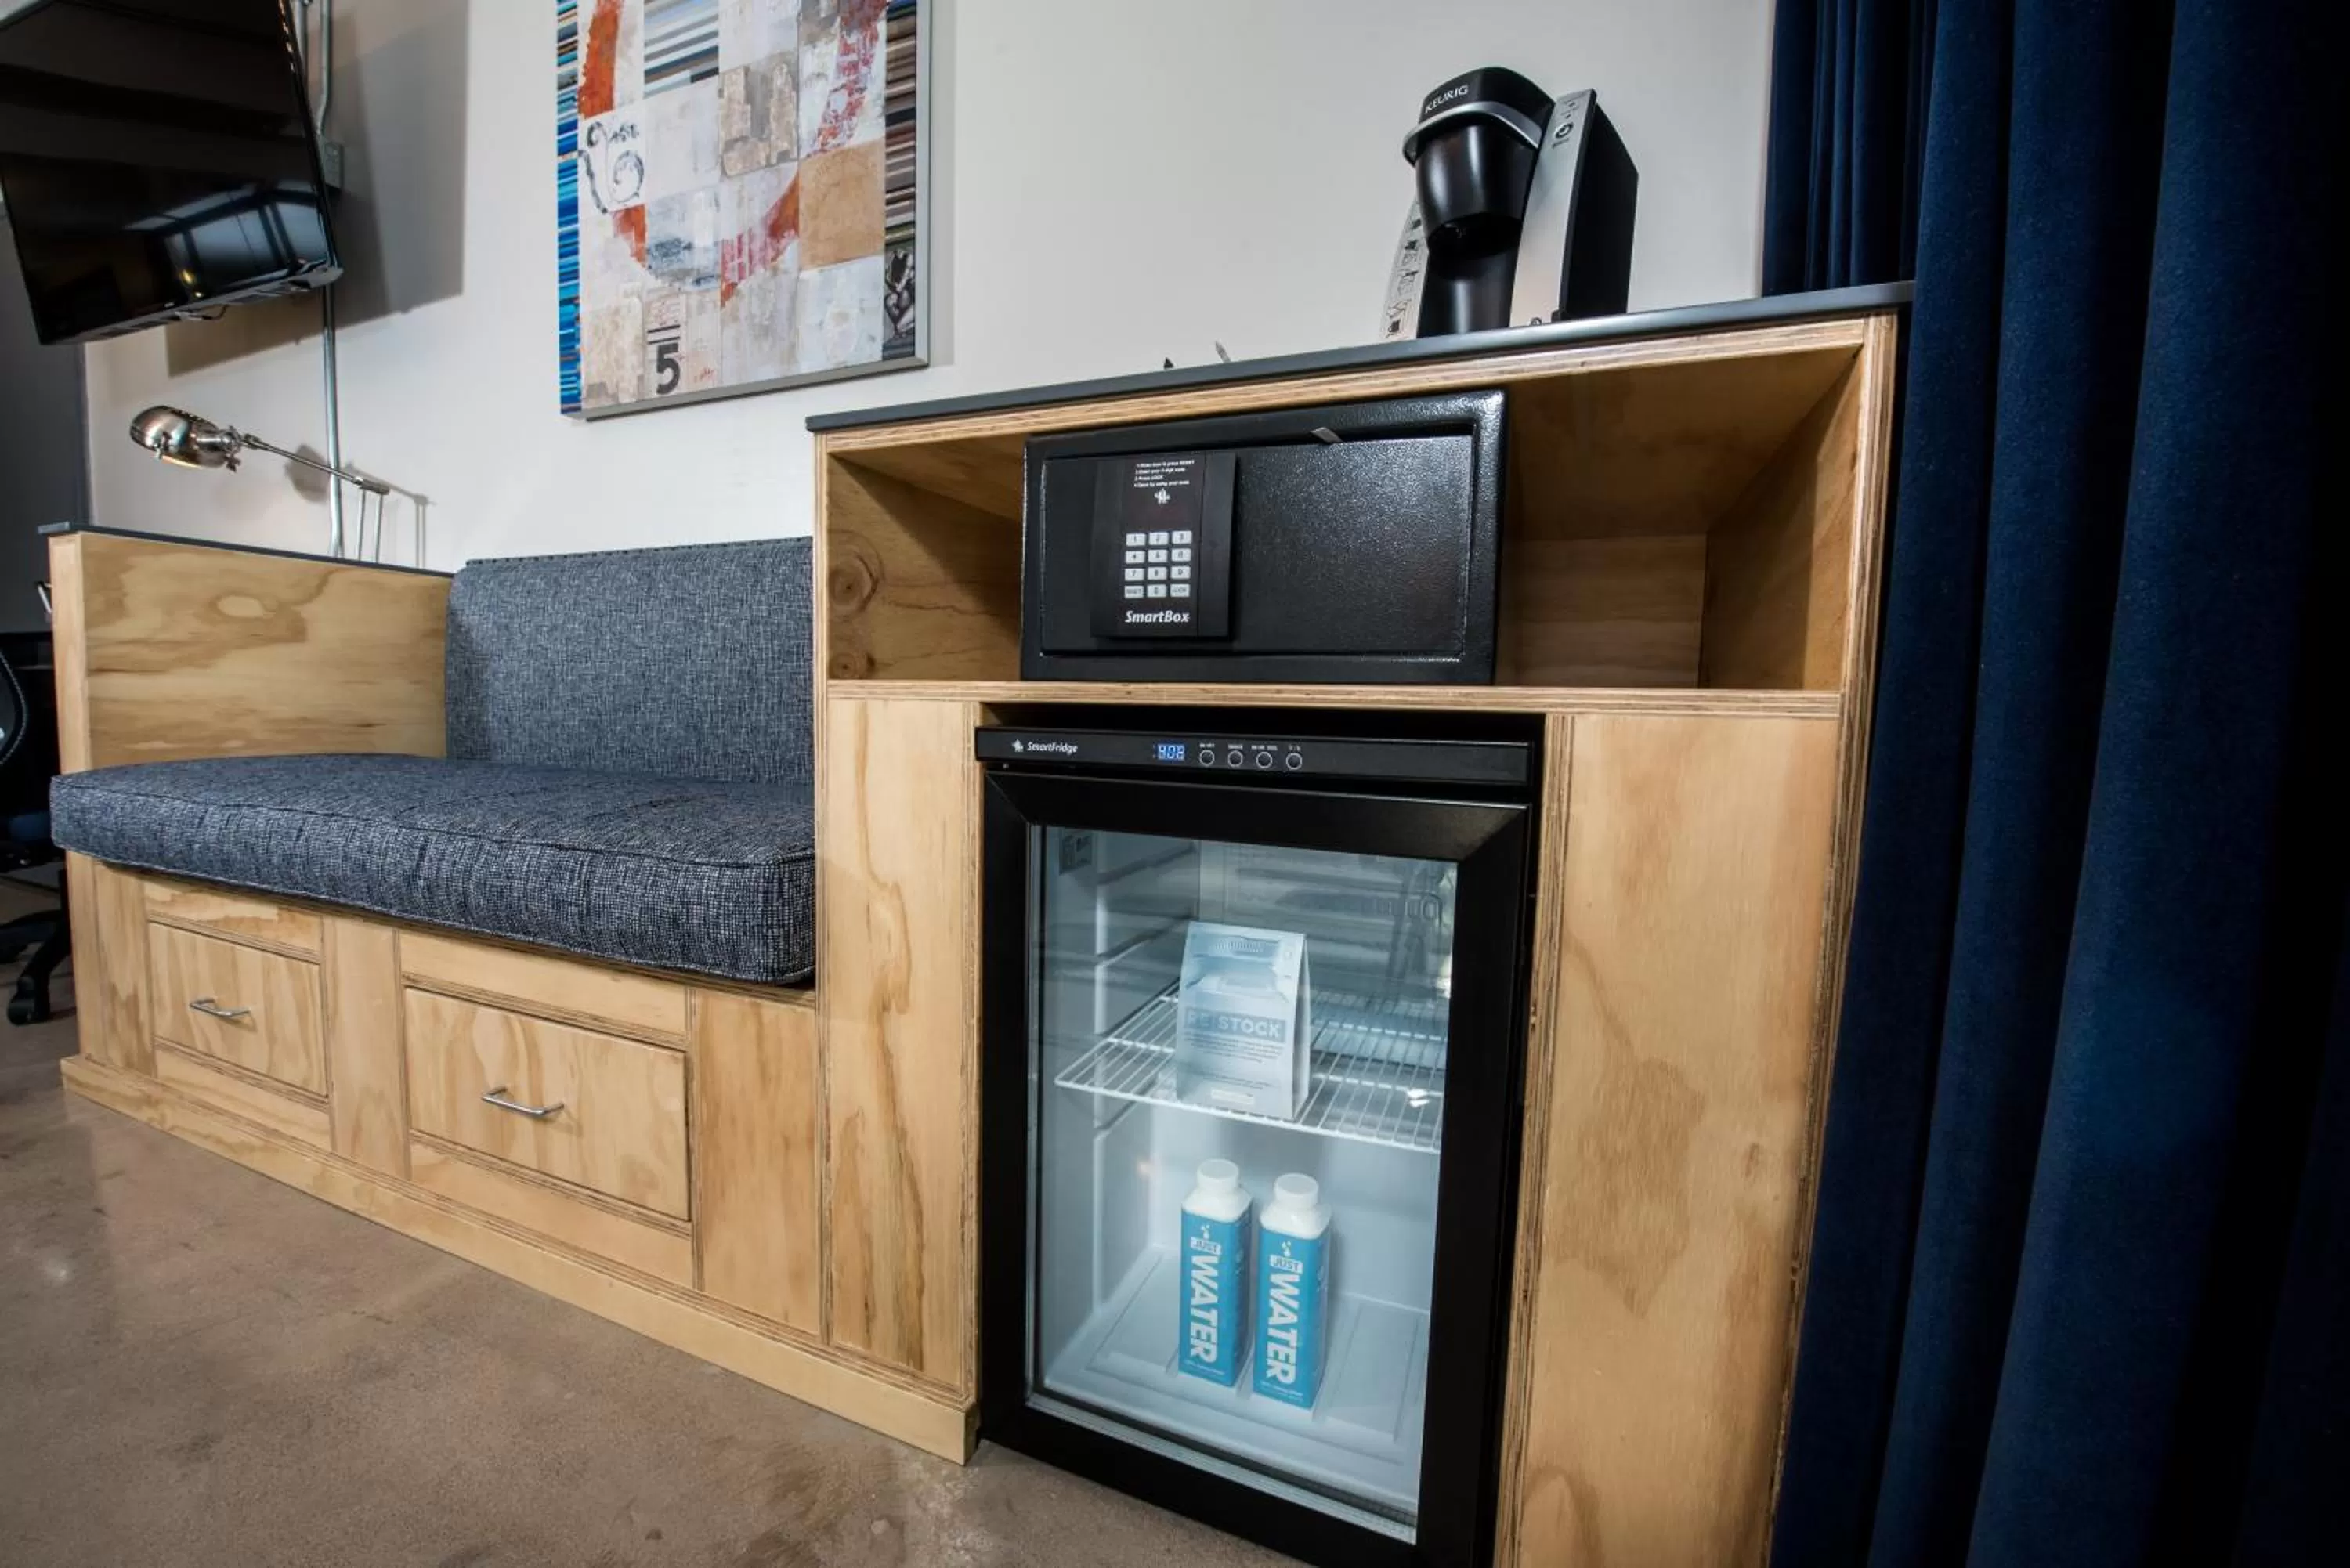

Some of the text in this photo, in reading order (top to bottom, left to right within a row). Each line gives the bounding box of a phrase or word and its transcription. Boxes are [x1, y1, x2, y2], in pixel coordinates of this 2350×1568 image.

[1425, 85, 1468, 113] KEURIG
[656, 342, 681, 395] 5
[1125, 609, 1190, 623] SmartBox
[1026, 741, 1079, 757] SmartFridge
[1273, 1256, 1299, 1271] JUST
[1190, 1255, 1219, 1364] WATER
[1265, 1273, 1300, 1384] WATER
